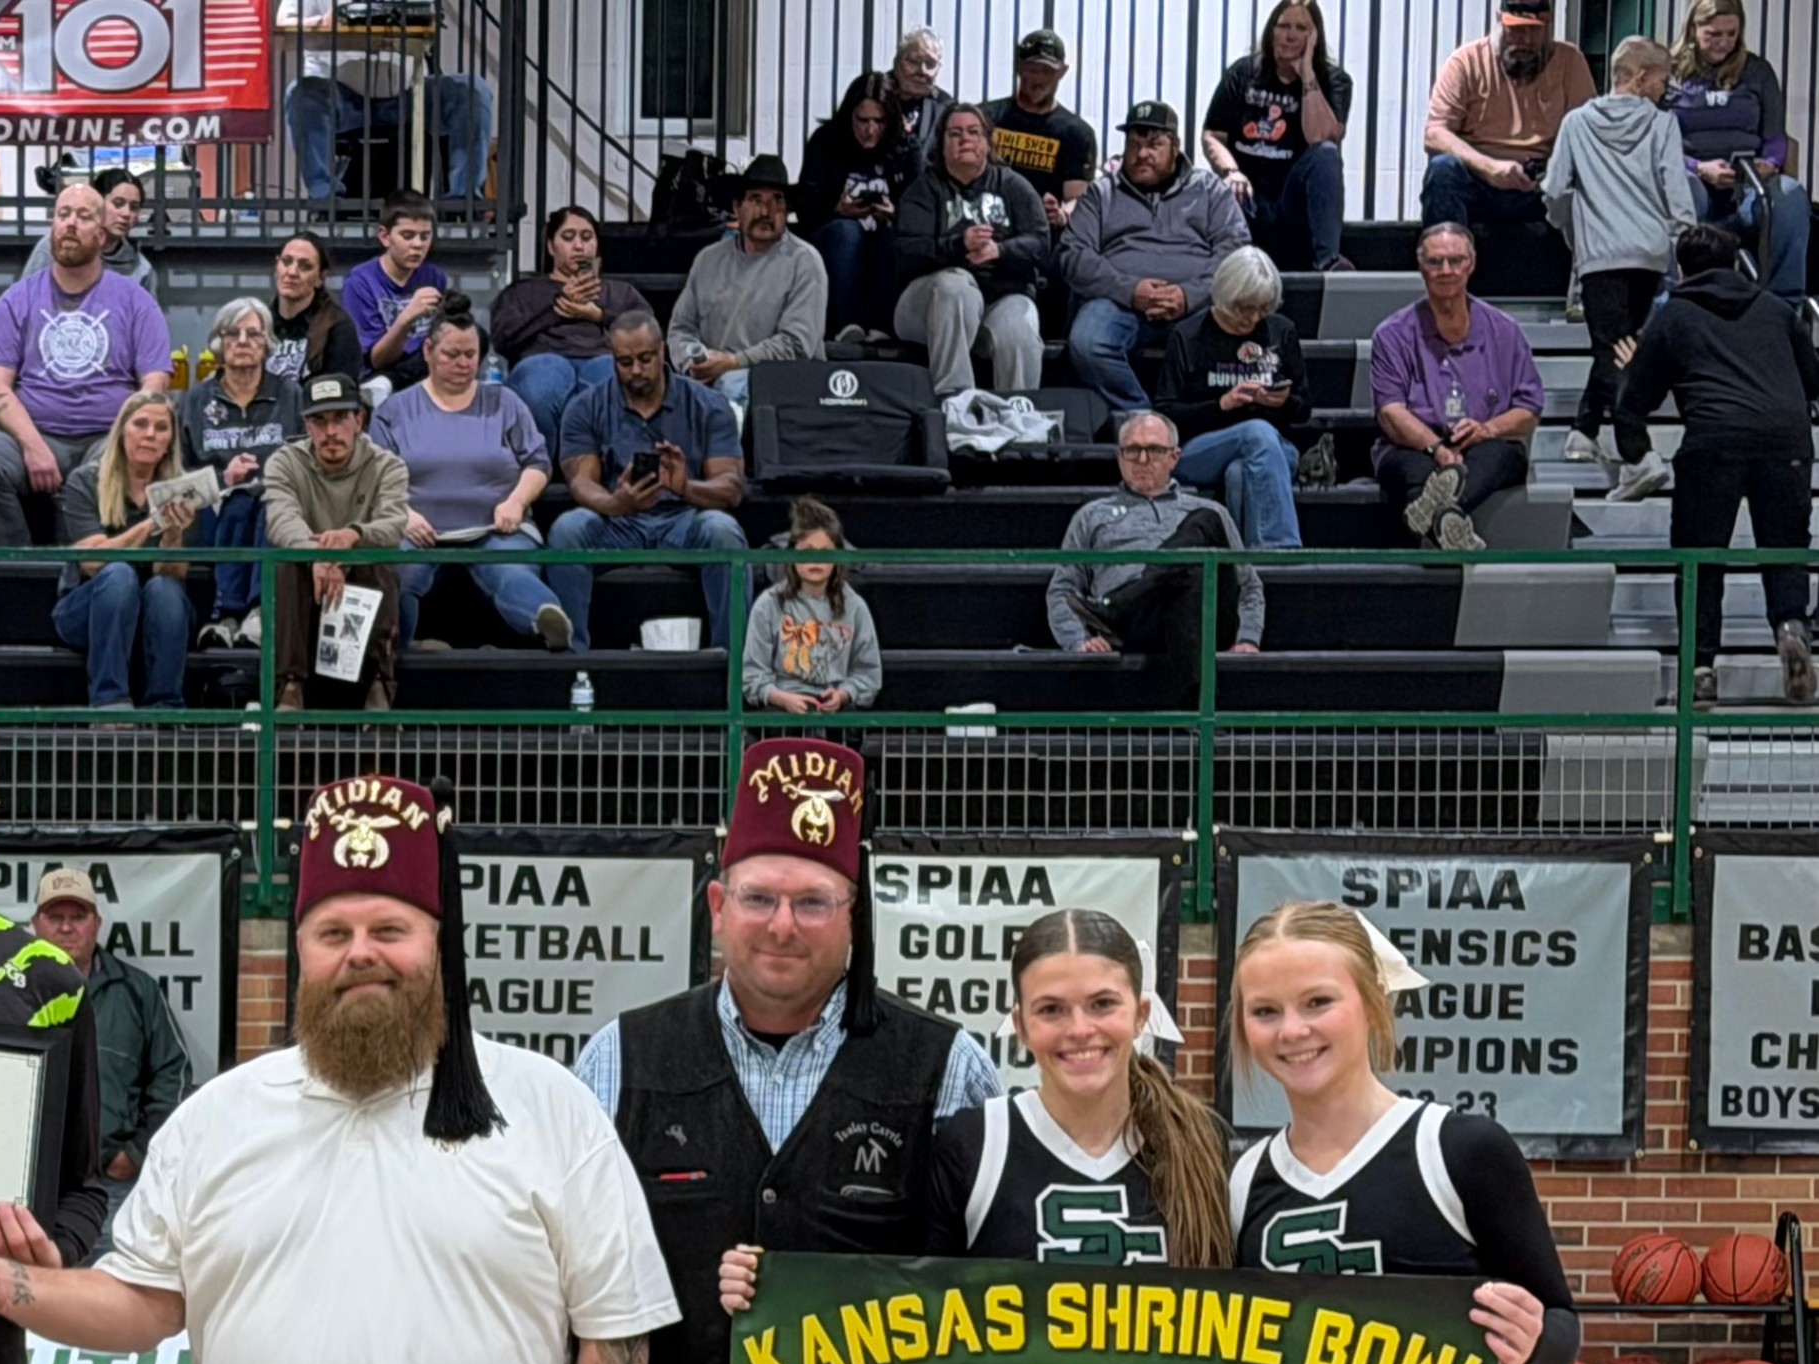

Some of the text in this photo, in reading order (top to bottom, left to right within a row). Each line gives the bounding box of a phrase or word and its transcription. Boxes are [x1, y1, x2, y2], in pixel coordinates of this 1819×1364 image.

[749, 751, 863, 815] MIDIAN
[305, 779, 430, 840] MIDIAN
[873, 863, 1056, 907] SPIAA
[1341, 867, 1526, 911] SPIAA
